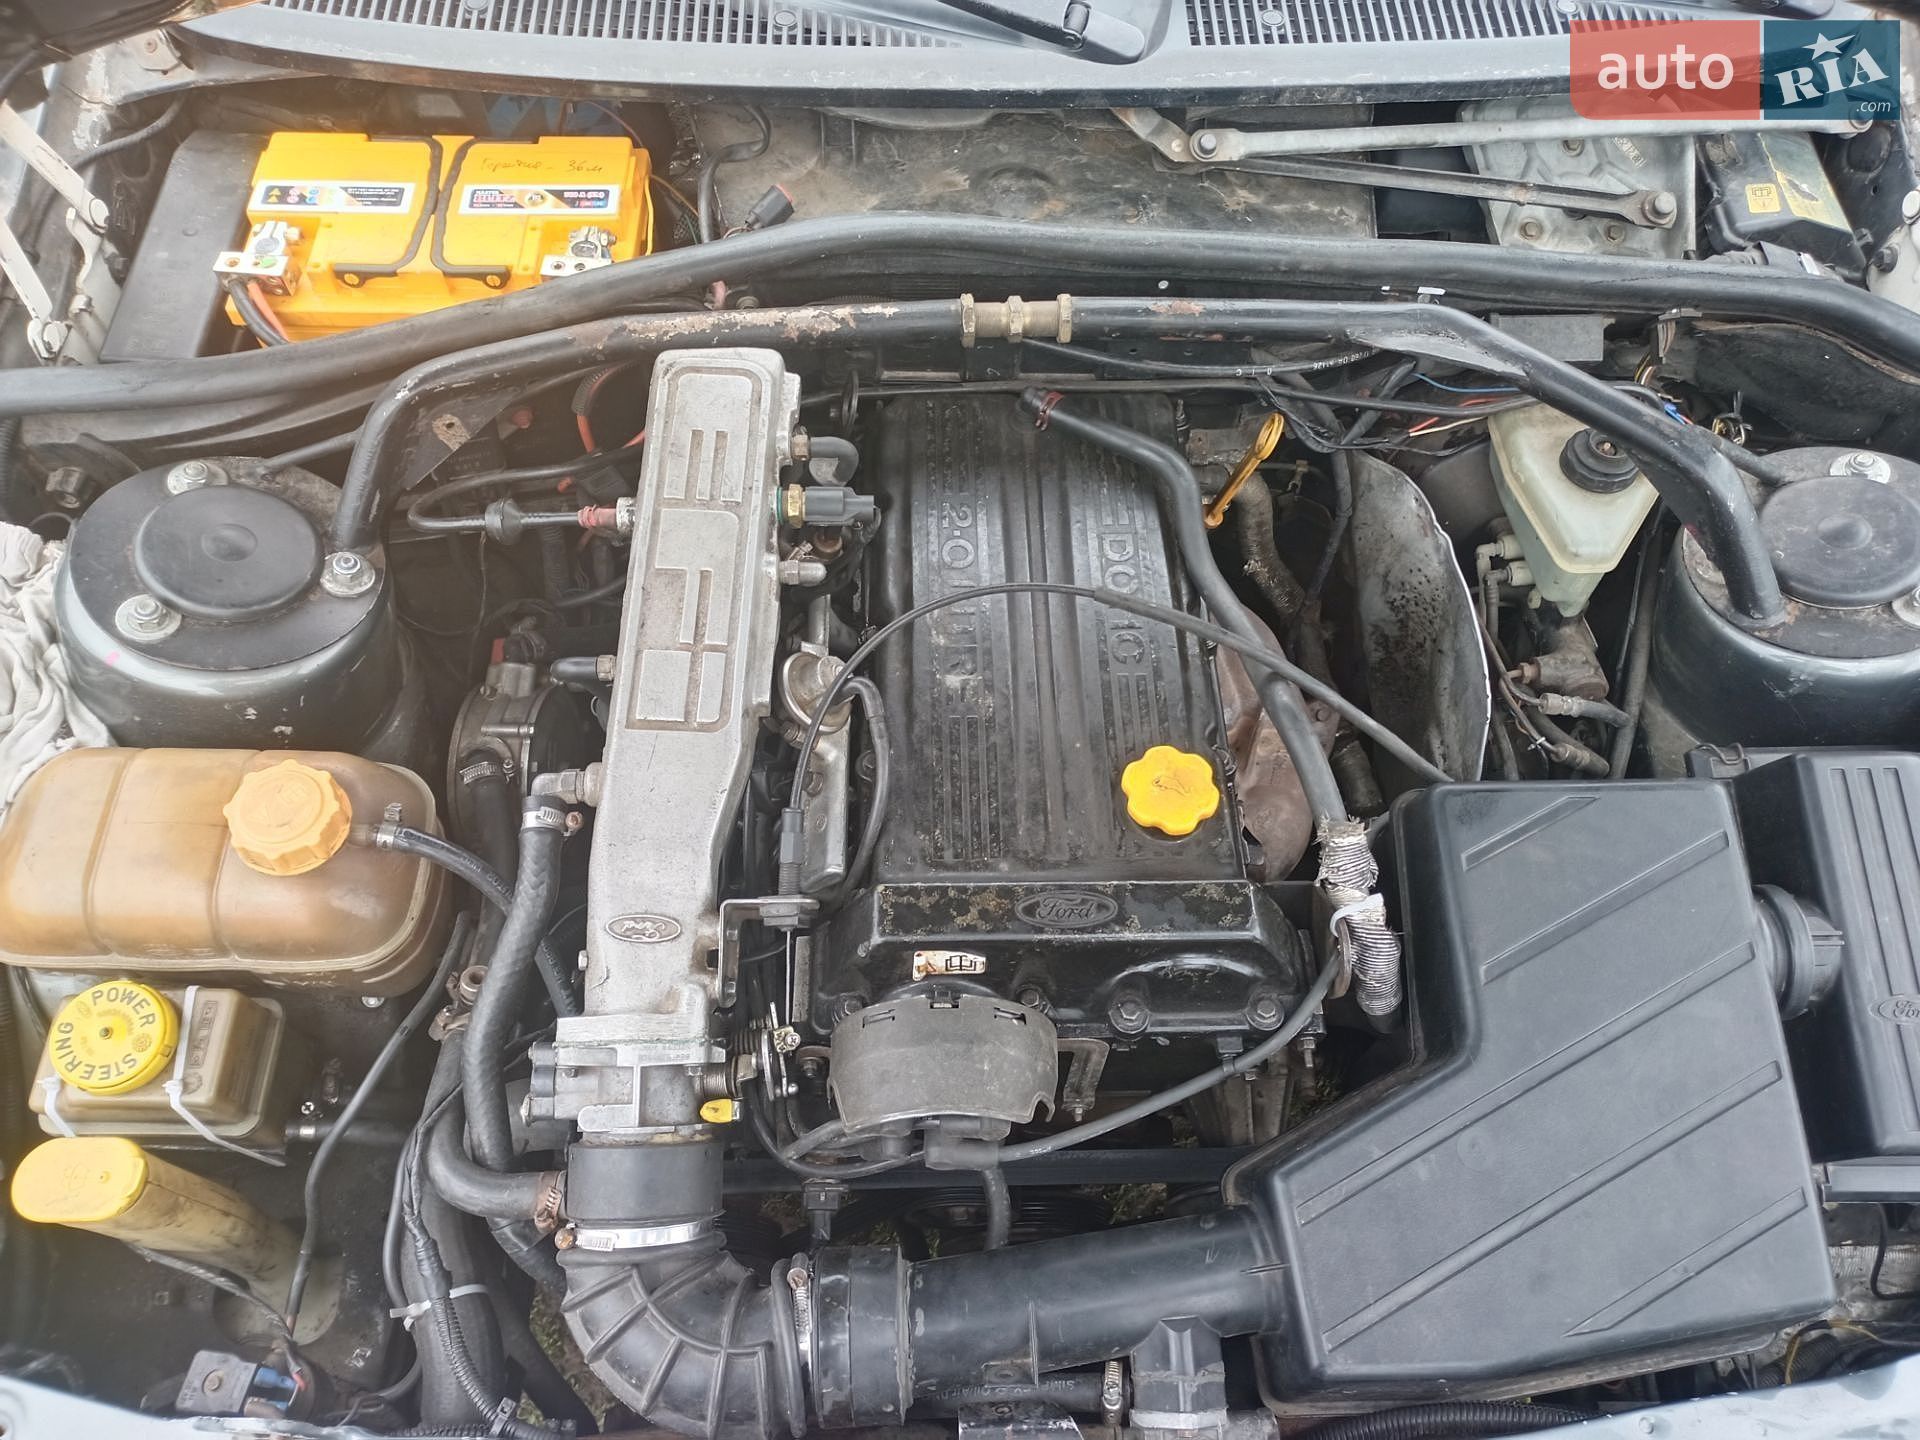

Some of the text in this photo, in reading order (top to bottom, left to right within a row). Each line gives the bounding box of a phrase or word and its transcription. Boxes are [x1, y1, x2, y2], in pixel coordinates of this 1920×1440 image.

[941, 502, 975, 569] 2.0
[91, 986, 156, 1028] POWER
[55, 1022, 138, 1081] STEERING
